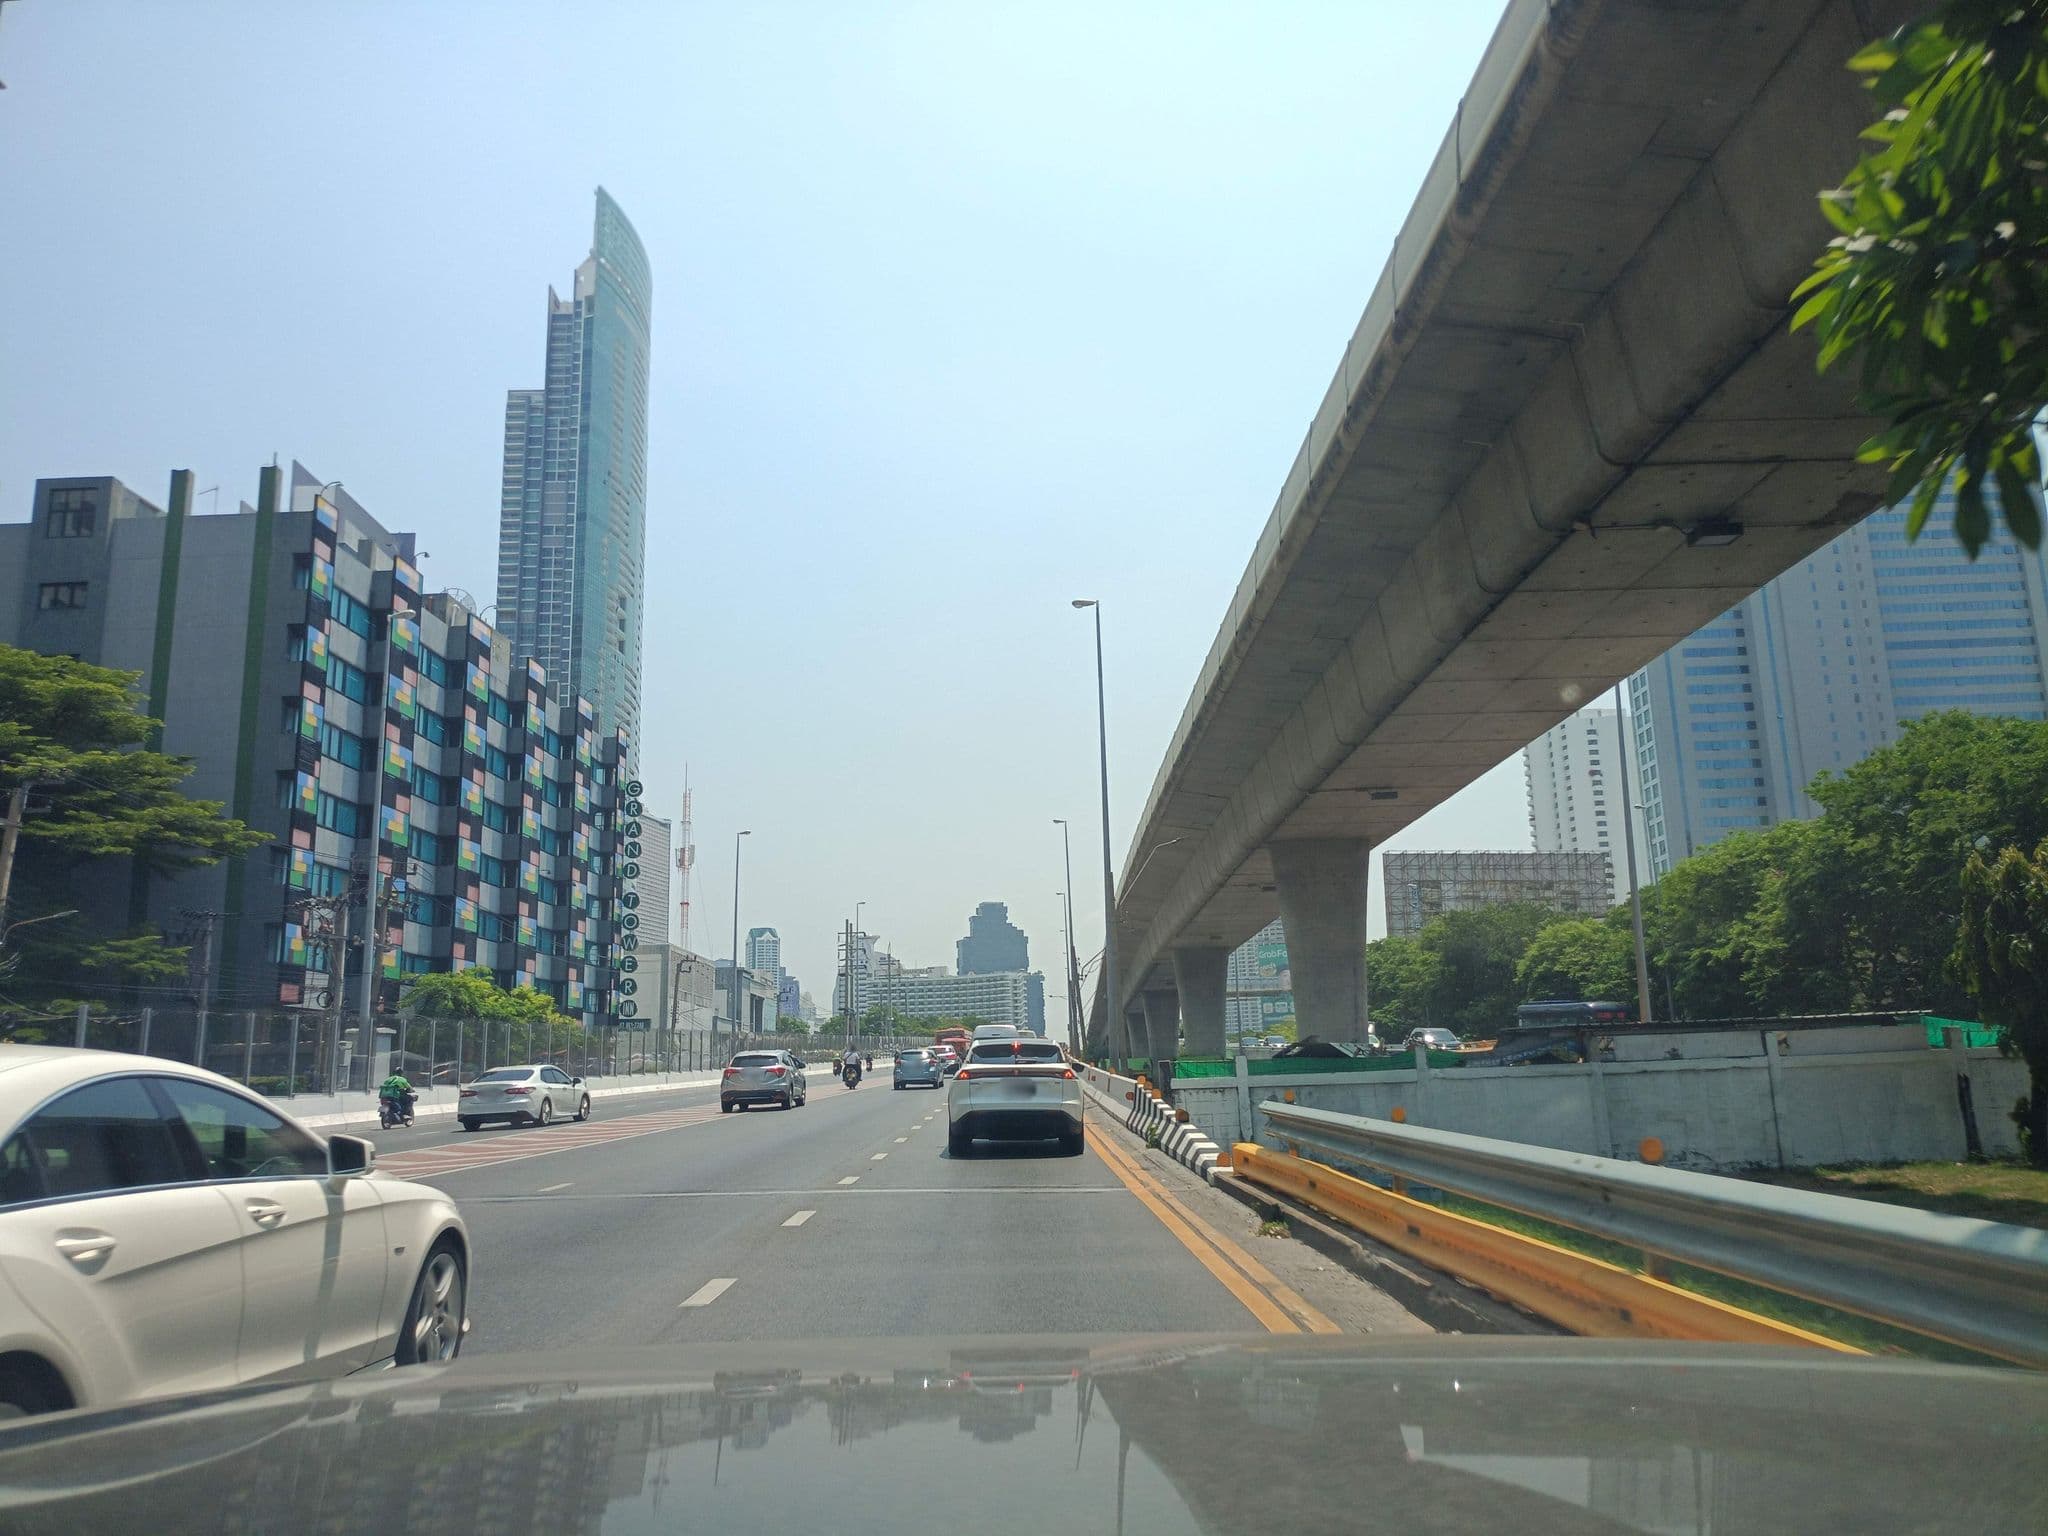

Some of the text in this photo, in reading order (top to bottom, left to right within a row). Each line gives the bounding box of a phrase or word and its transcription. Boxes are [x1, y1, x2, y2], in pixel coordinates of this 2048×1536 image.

[627, 783, 641, 877] GRAND
[623, 894, 638, 994] TOWER
[622, 1001, 635, 1016] INN
